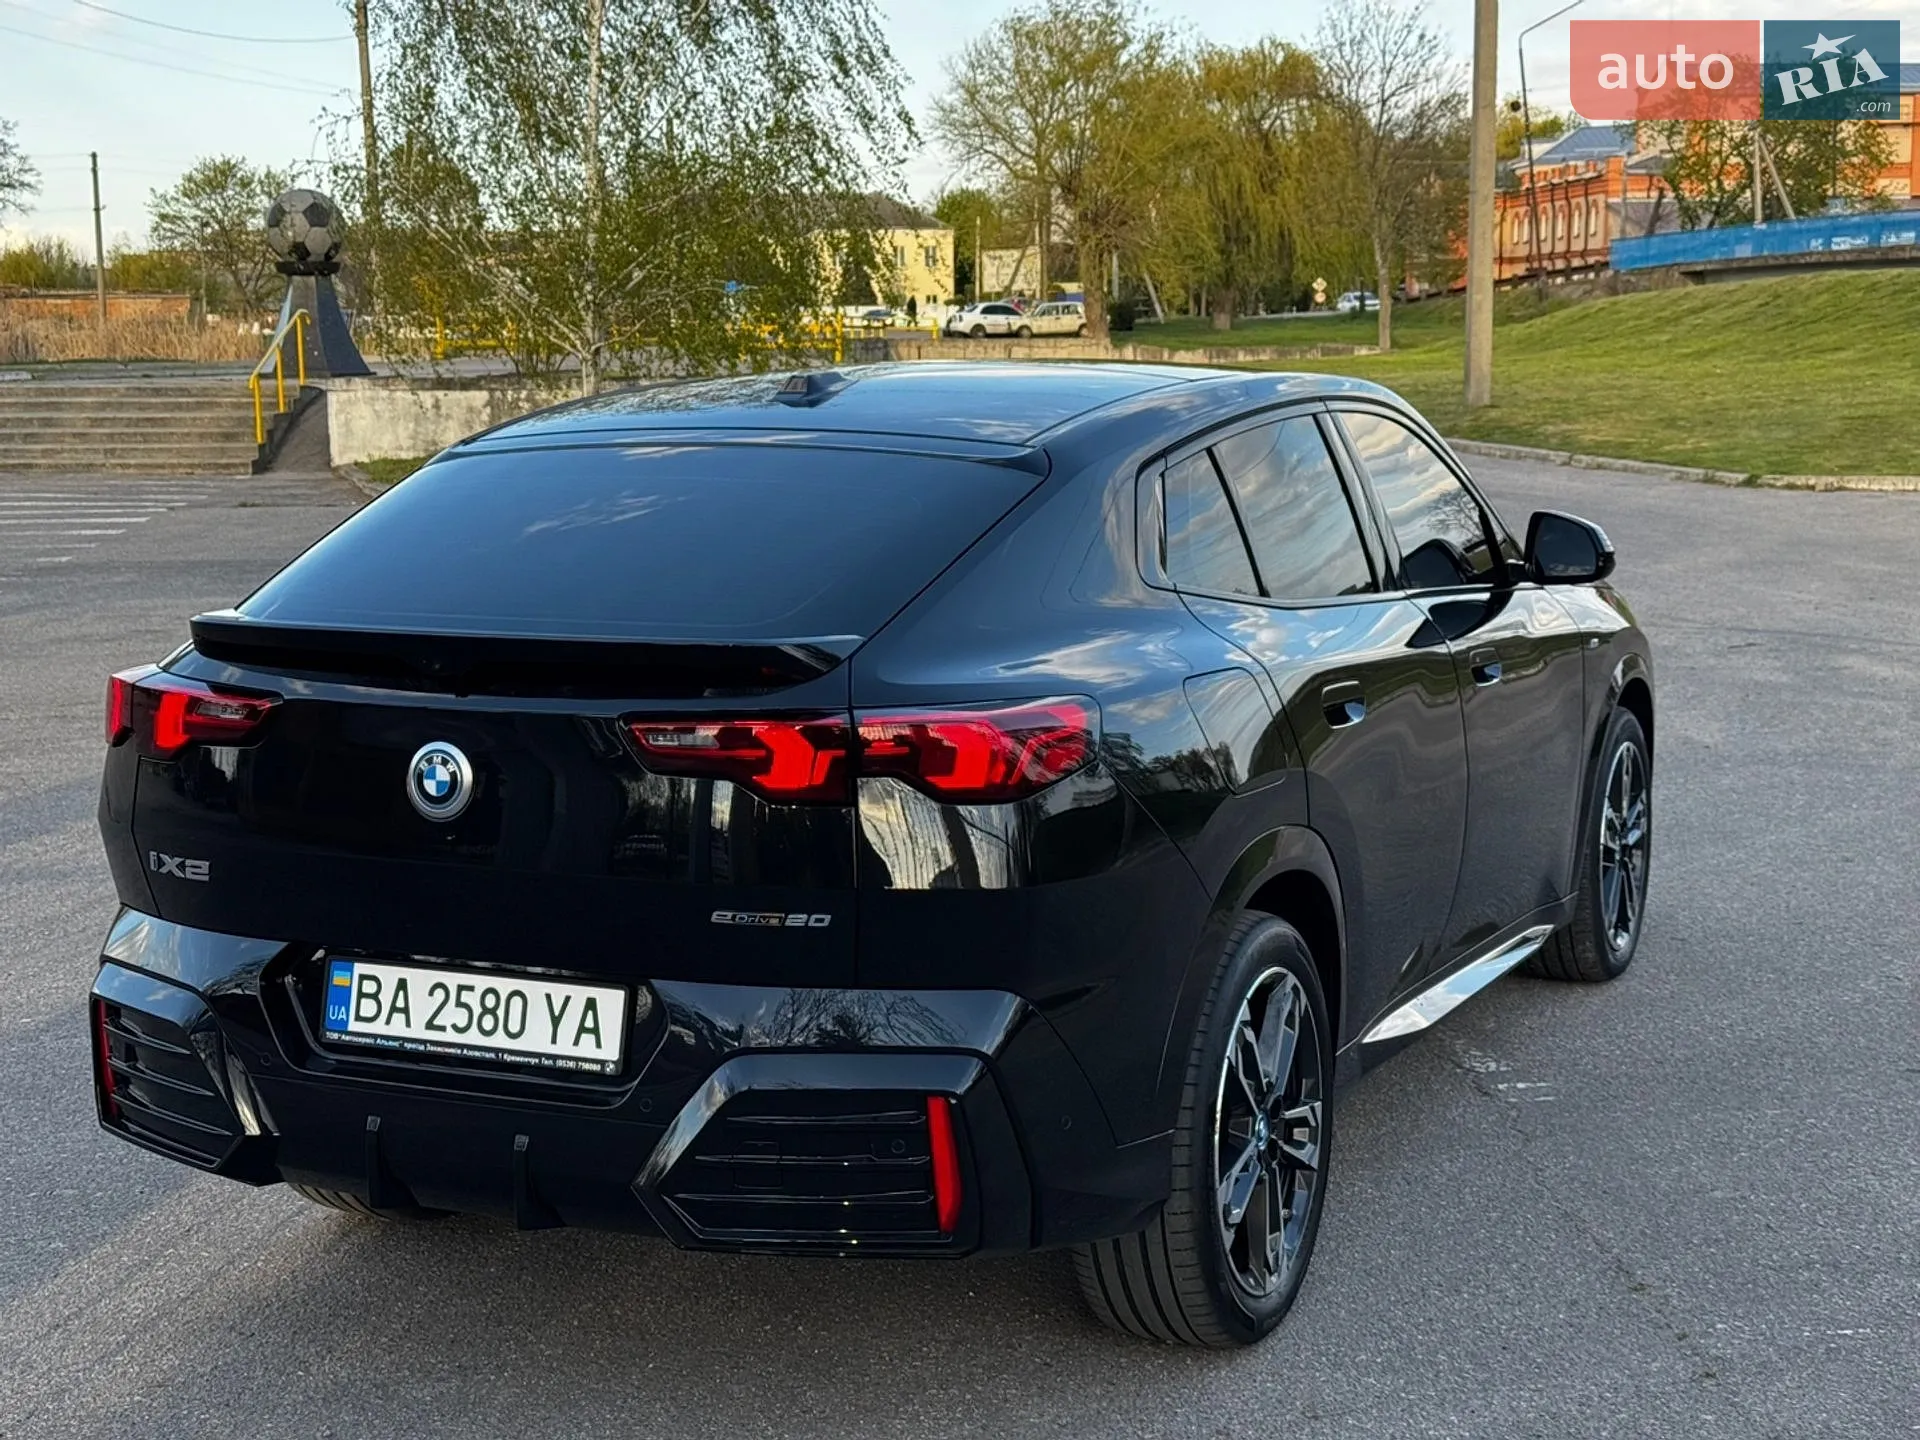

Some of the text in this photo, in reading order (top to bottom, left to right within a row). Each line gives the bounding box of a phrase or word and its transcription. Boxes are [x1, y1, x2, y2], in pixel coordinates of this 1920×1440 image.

[328, 1003, 348, 1022] UA
[354, 973, 603, 1050] BA 2580 YA
